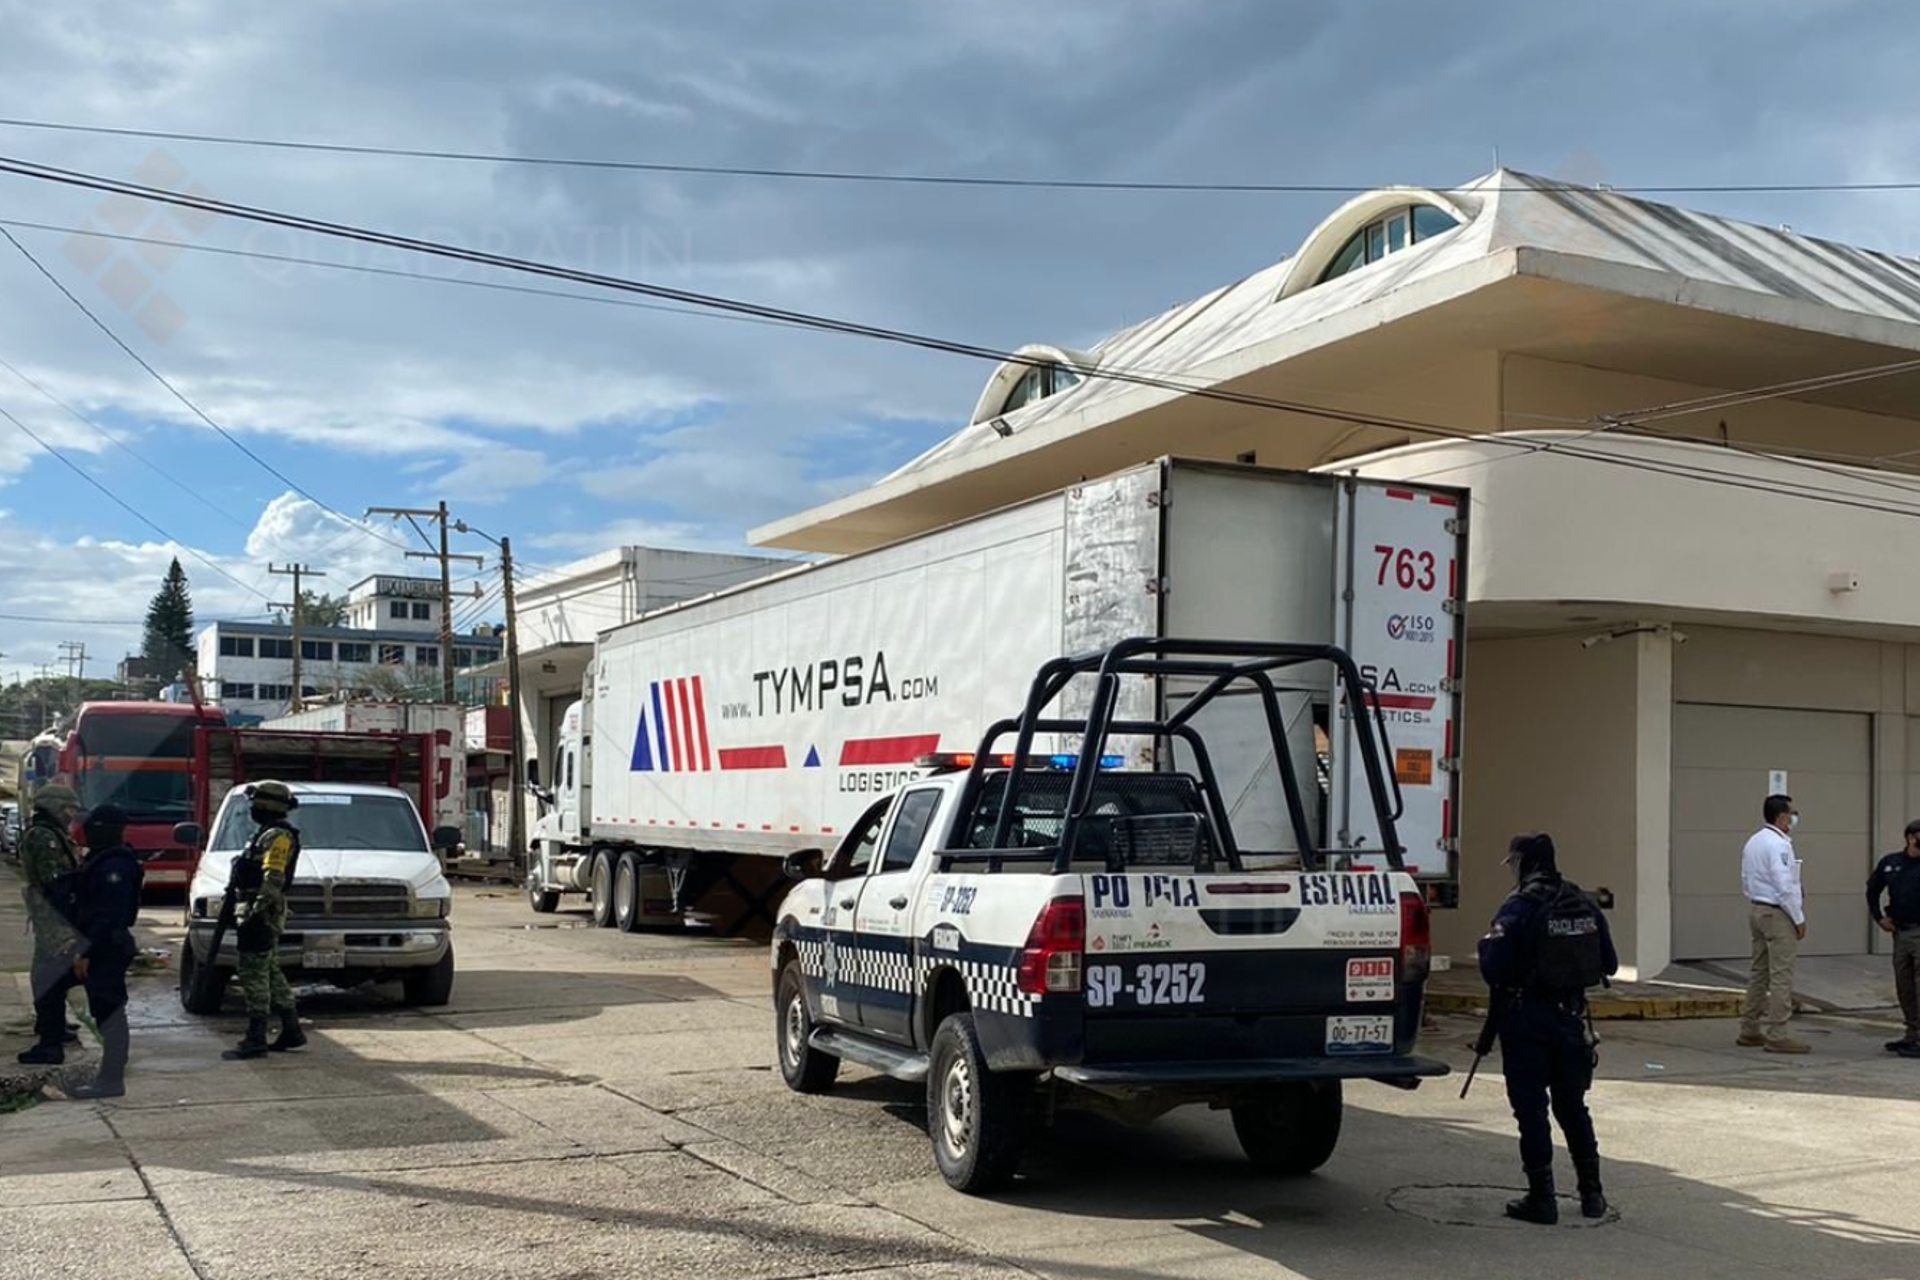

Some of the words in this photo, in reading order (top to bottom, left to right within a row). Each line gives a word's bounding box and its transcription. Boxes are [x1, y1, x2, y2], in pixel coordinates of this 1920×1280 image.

[1375, 545, 1435, 591] 763
[1410, 615, 1434, 631] ISO
[1299, 872, 1396, 906] ESTATAL
[1087, 962, 1206, 1008] SP-3252
[1351, 962, 1388, 976] 911
